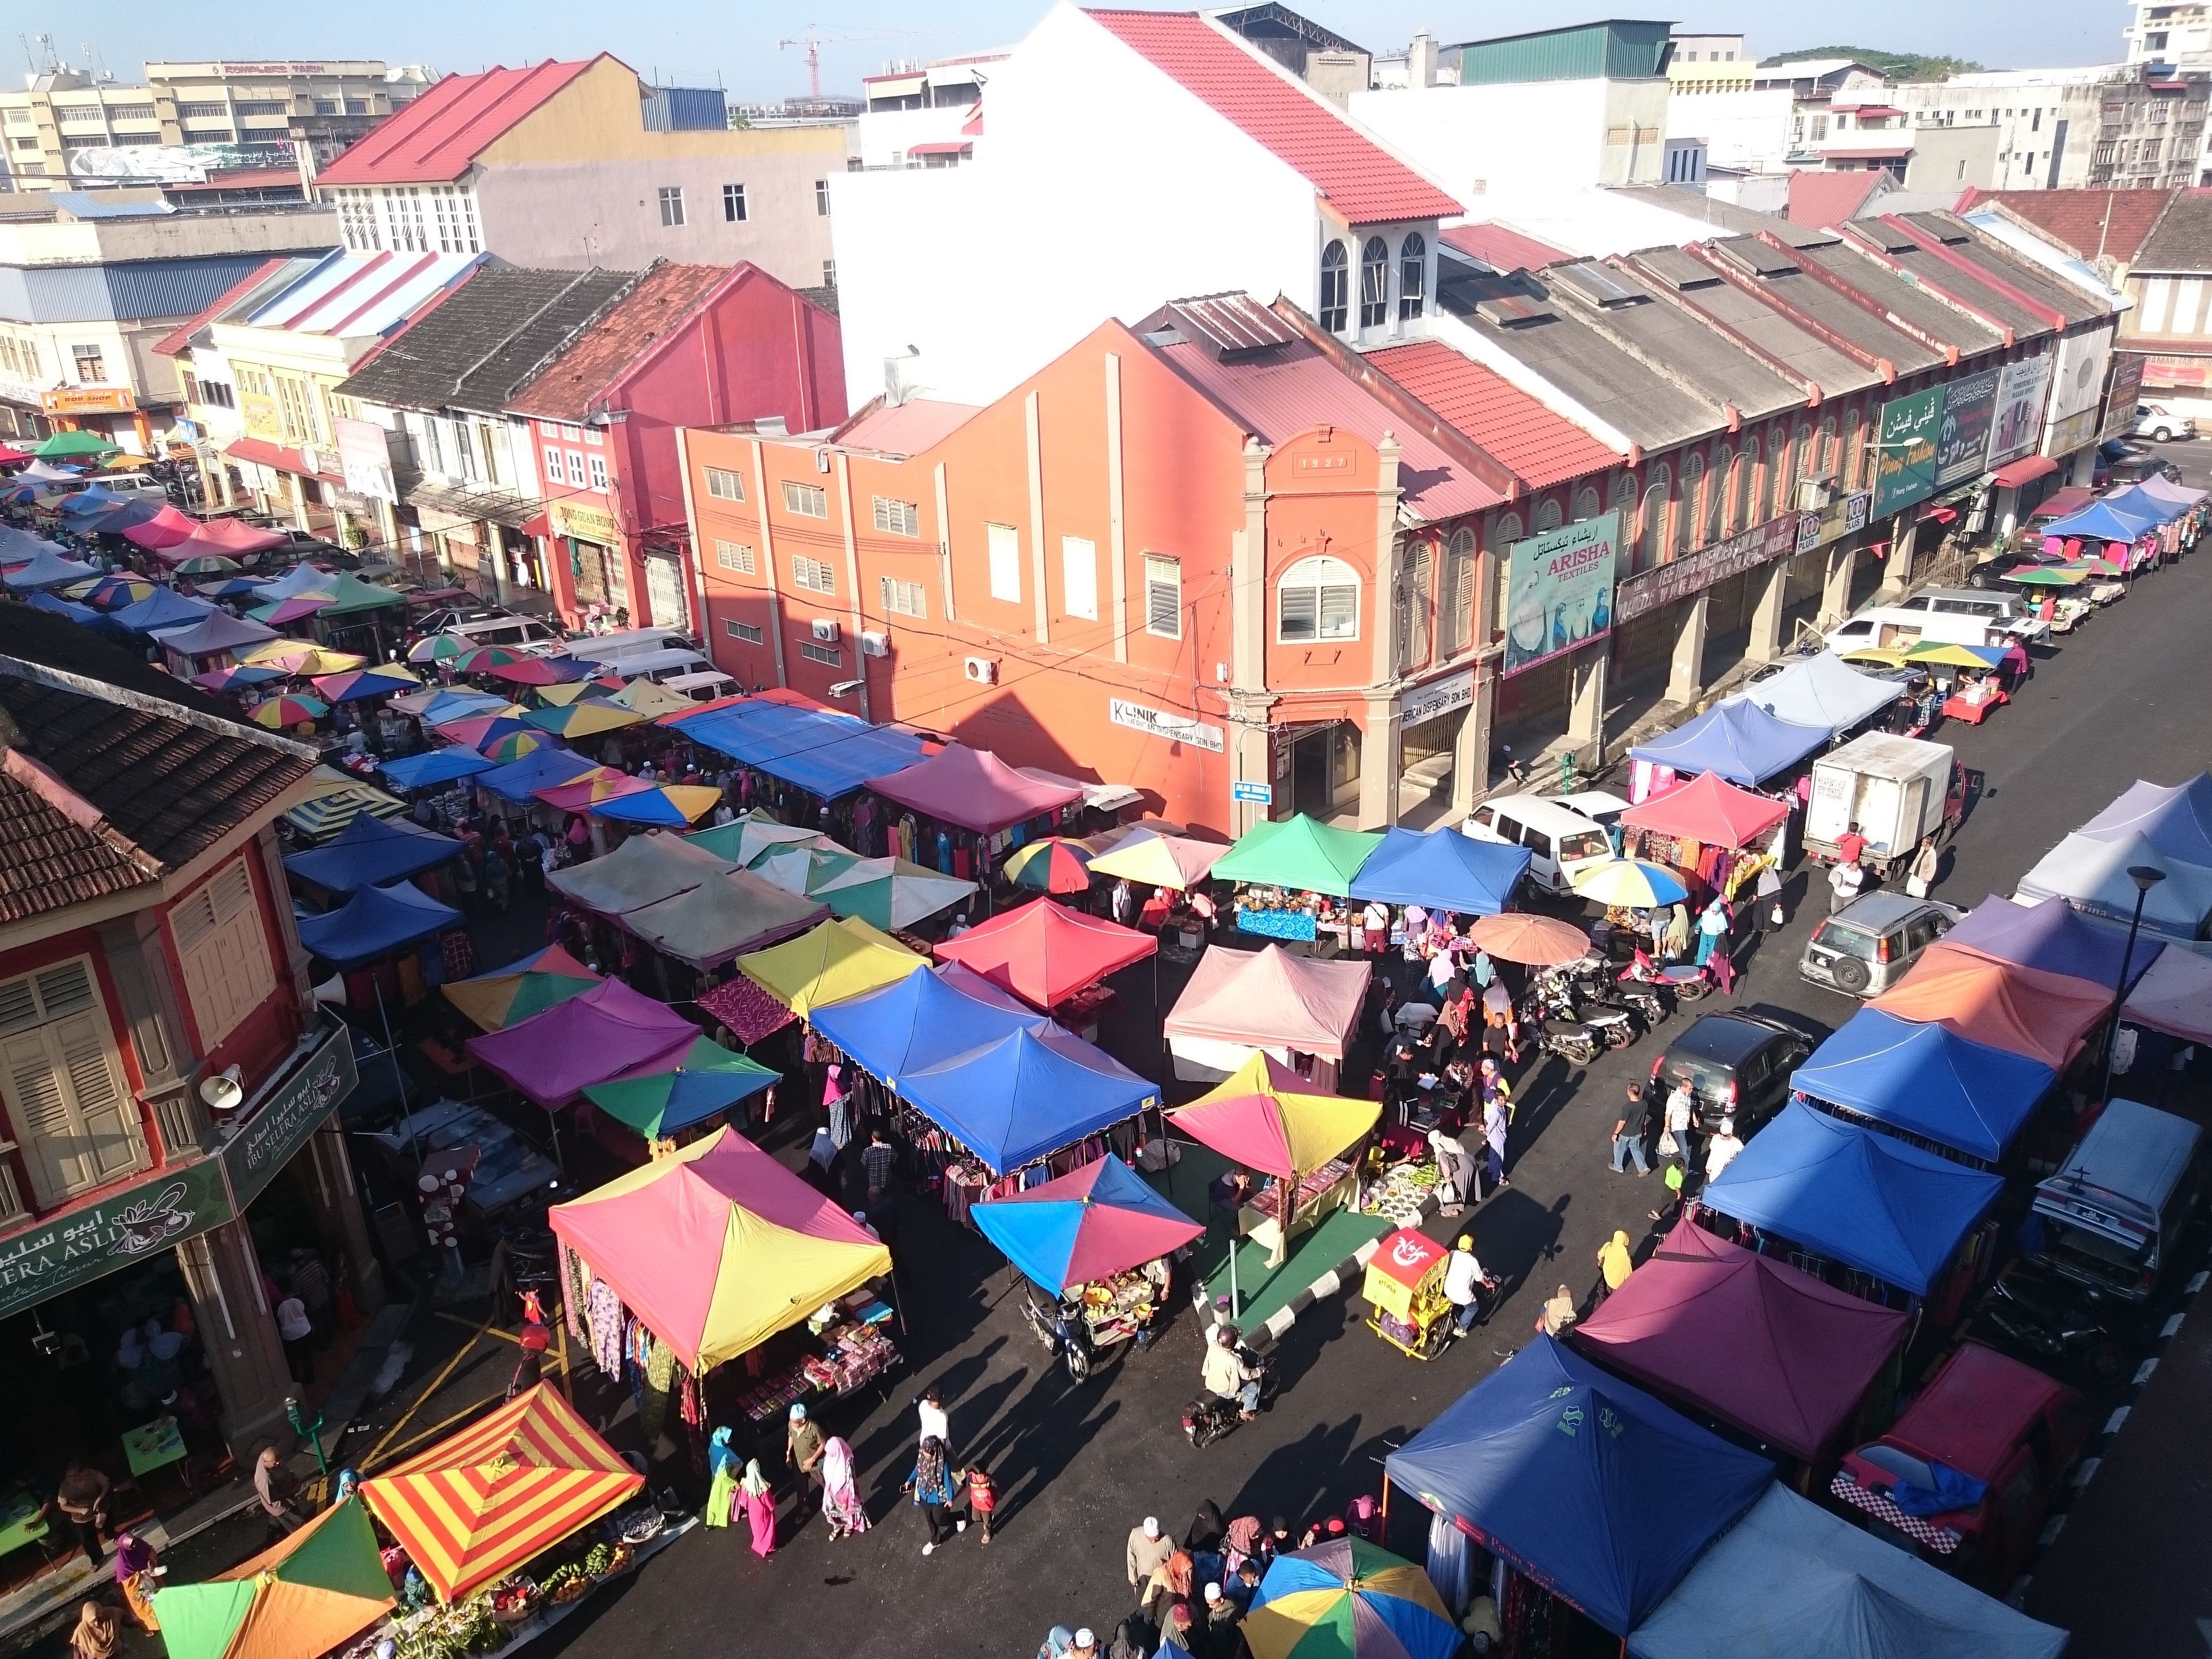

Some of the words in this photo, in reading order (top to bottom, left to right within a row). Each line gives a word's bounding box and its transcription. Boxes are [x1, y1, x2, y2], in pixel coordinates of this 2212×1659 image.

[1302, 457, 1345, 469] 1927
[560, 506, 577, 520] TONG
[578, 511, 595, 524] GUAN
[1849, 497, 1864, 520] 100
[1844, 518, 1860, 532] PLUS
[1798, 538, 1815, 551] PLUS
[1547, 541, 1610, 576] ARISHA
[1658, 564, 1675, 588] TEE
[1675, 555, 1697, 581] HENG
[1697, 540, 1734, 571] AGENCIES
[1558, 562, 1599, 583] TEXTILES
[1423, 694, 1450, 715] DISPENSARY
[1451, 691, 1461, 704] SDN.
[1461, 687, 1471, 700] BHD.
[1157, 725, 1194, 741] DISPENSARY
[247, 1145, 264, 1169] IBU
[265, 1112, 297, 1150] SELERA
[298, 1090, 317, 1115] ASLI
[0, 1255, 56, 1289] ERA
[64, 1226, 119, 1262] ASLI
